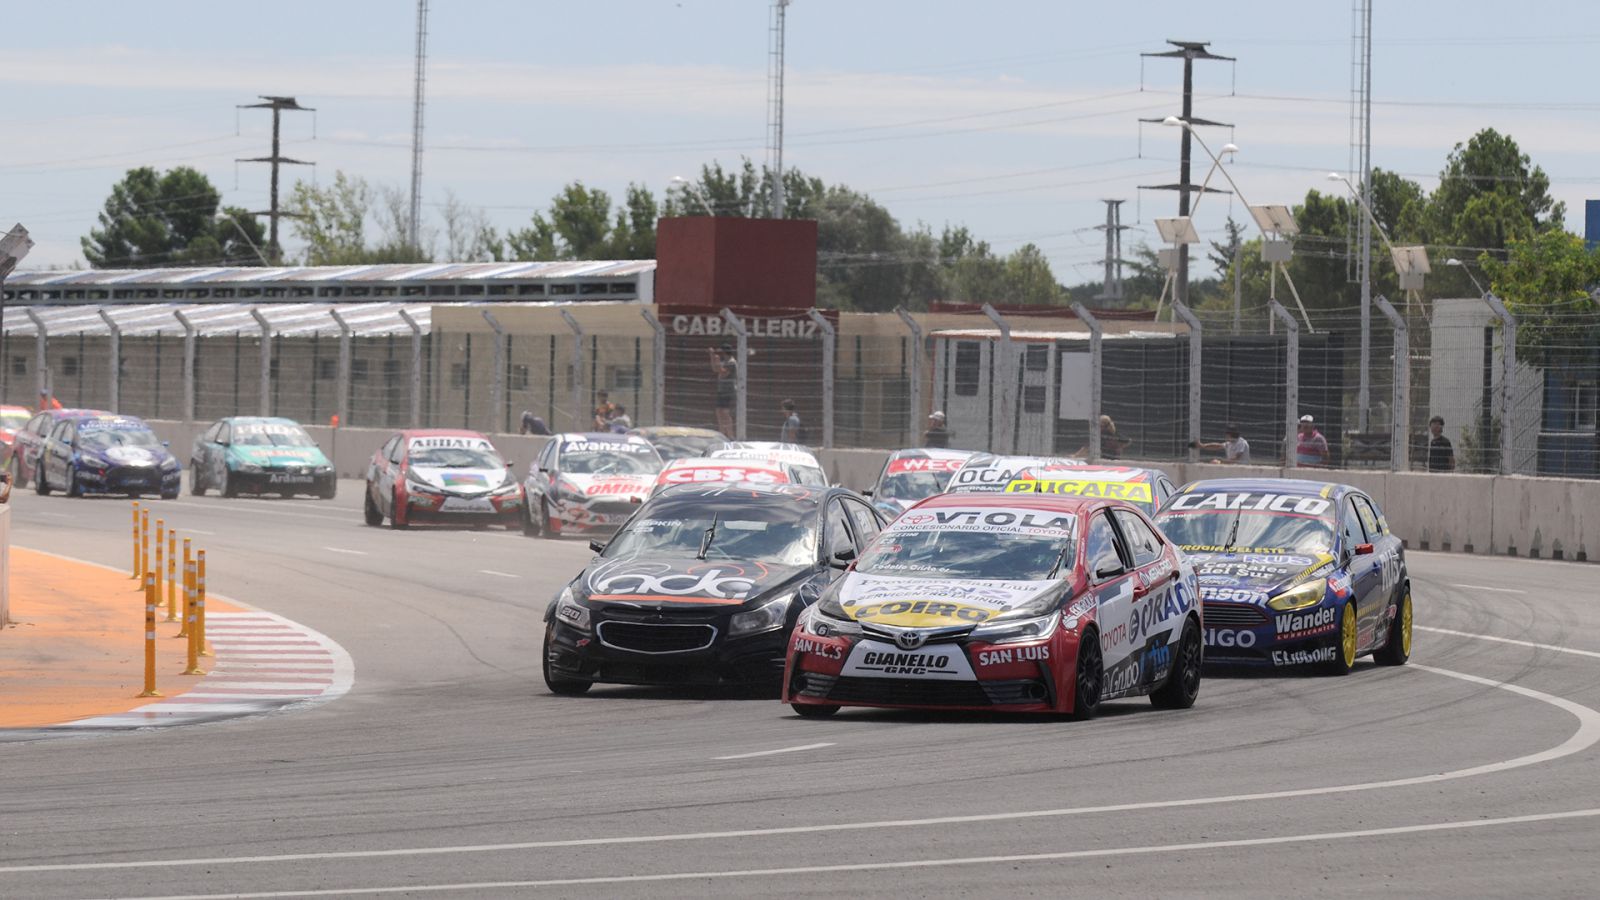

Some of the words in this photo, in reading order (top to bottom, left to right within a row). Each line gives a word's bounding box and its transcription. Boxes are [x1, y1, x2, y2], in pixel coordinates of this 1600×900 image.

[672, 314, 827, 339] CABALLERIZ
[565, 442, 640, 452] Avanzar
[959, 469, 1013, 483] OCA
[1013, 481, 1148, 500] PUCARA
[1170, 493, 1331, 515] CALICO
[893, 523, 981, 532] CONCESIONARIO
[1028, 527, 1070, 536] TOYOTA
[1237, 568, 1274, 579] Sur
[562, 607, 580, 619] 20
[855, 601, 990, 621] COIRO
[1275, 607, 1336, 634] Wander
[818, 626, 829, 636] 6
[815, 643, 843, 660] LUS
[863, 651, 950, 668] GIANELLO
[979, 649, 1013, 667] SAN
[1016, 645, 1051, 662] LUIS
[883, 666, 927, 676] GNC
